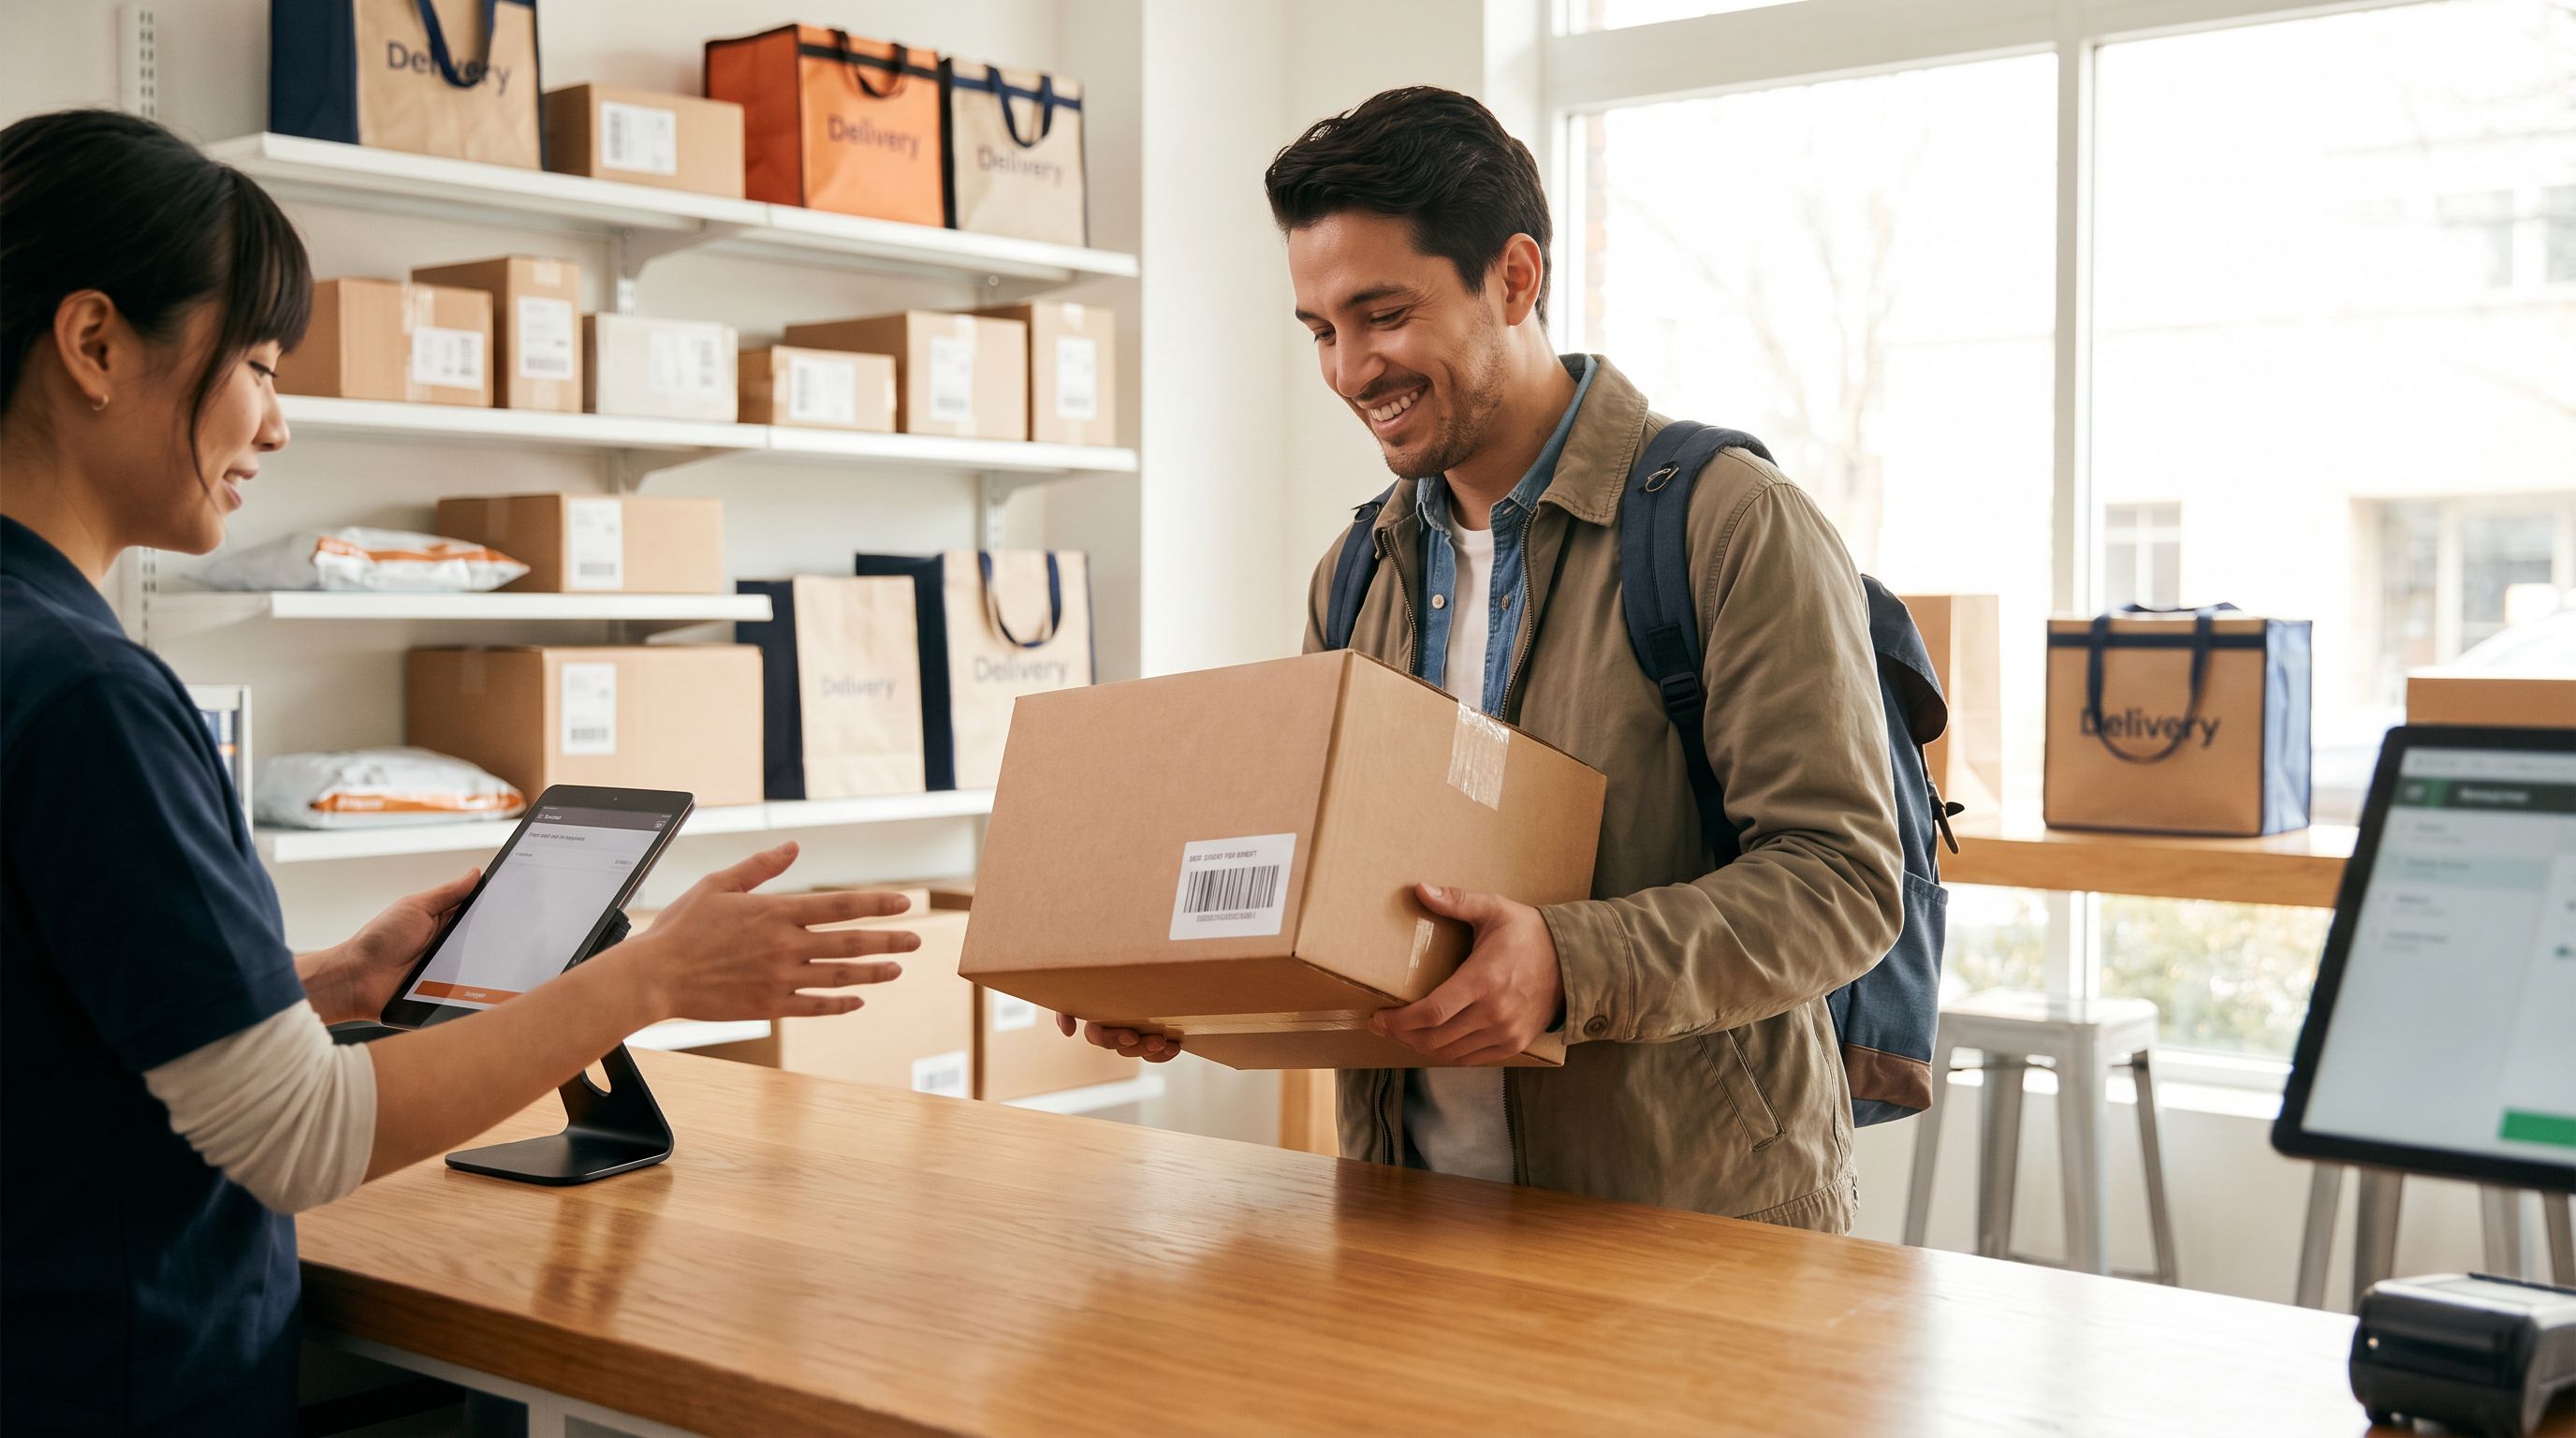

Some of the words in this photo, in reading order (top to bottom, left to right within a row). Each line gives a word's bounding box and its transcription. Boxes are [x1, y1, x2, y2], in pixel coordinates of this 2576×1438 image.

[388, 41, 511, 96] Devery
[827, 114, 921, 161] Delivery
[977, 145, 1064, 185] Delivery
[820, 674, 897, 698] Delivery
[974, 655, 1069, 685] Delivery
